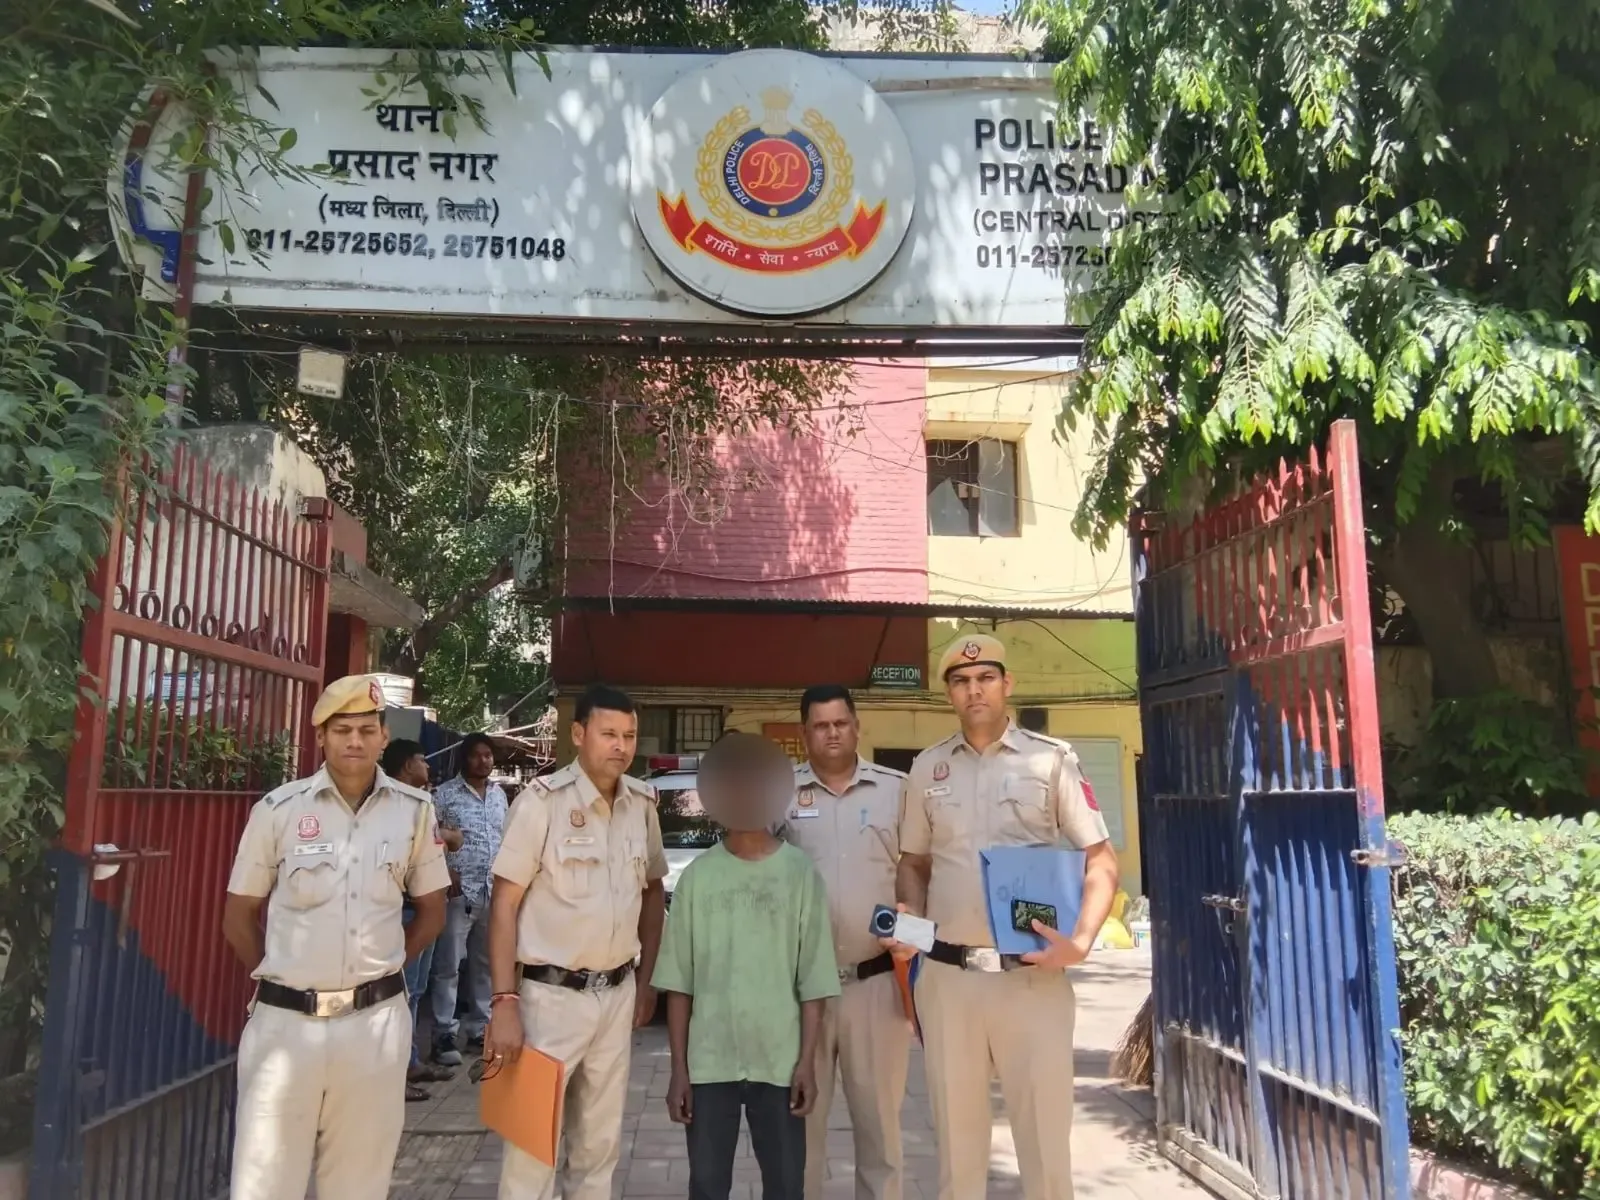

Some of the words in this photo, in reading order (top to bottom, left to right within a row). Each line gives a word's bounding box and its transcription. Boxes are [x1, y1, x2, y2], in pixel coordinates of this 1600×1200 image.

[376, 103, 457, 133] थान
[428, 152, 498, 184] नगर
[726, 140, 745, 174] POLICE
[727, 175, 751, 206] DELHI
[807, 168, 823, 196] दिल्ली
[980, 162, 1128, 196] PRASAD
[318, 193, 367, 224] (मध्य
[372, 194, 428, 225] जिला,
[437, 196, 499, 228] दिल्ली)
[974, 209, 1100, 236] (CENTRAL
[247, 228, 435, 260] 011-25725652,
[443, 234, 566, 261] 25751048
[704, 234, 739, 258] शांति
[758, 250, 784, 265] सेवा
[804, 241, 839, 258] न्याय
[871, 667, 921, 680] RECEPTION
